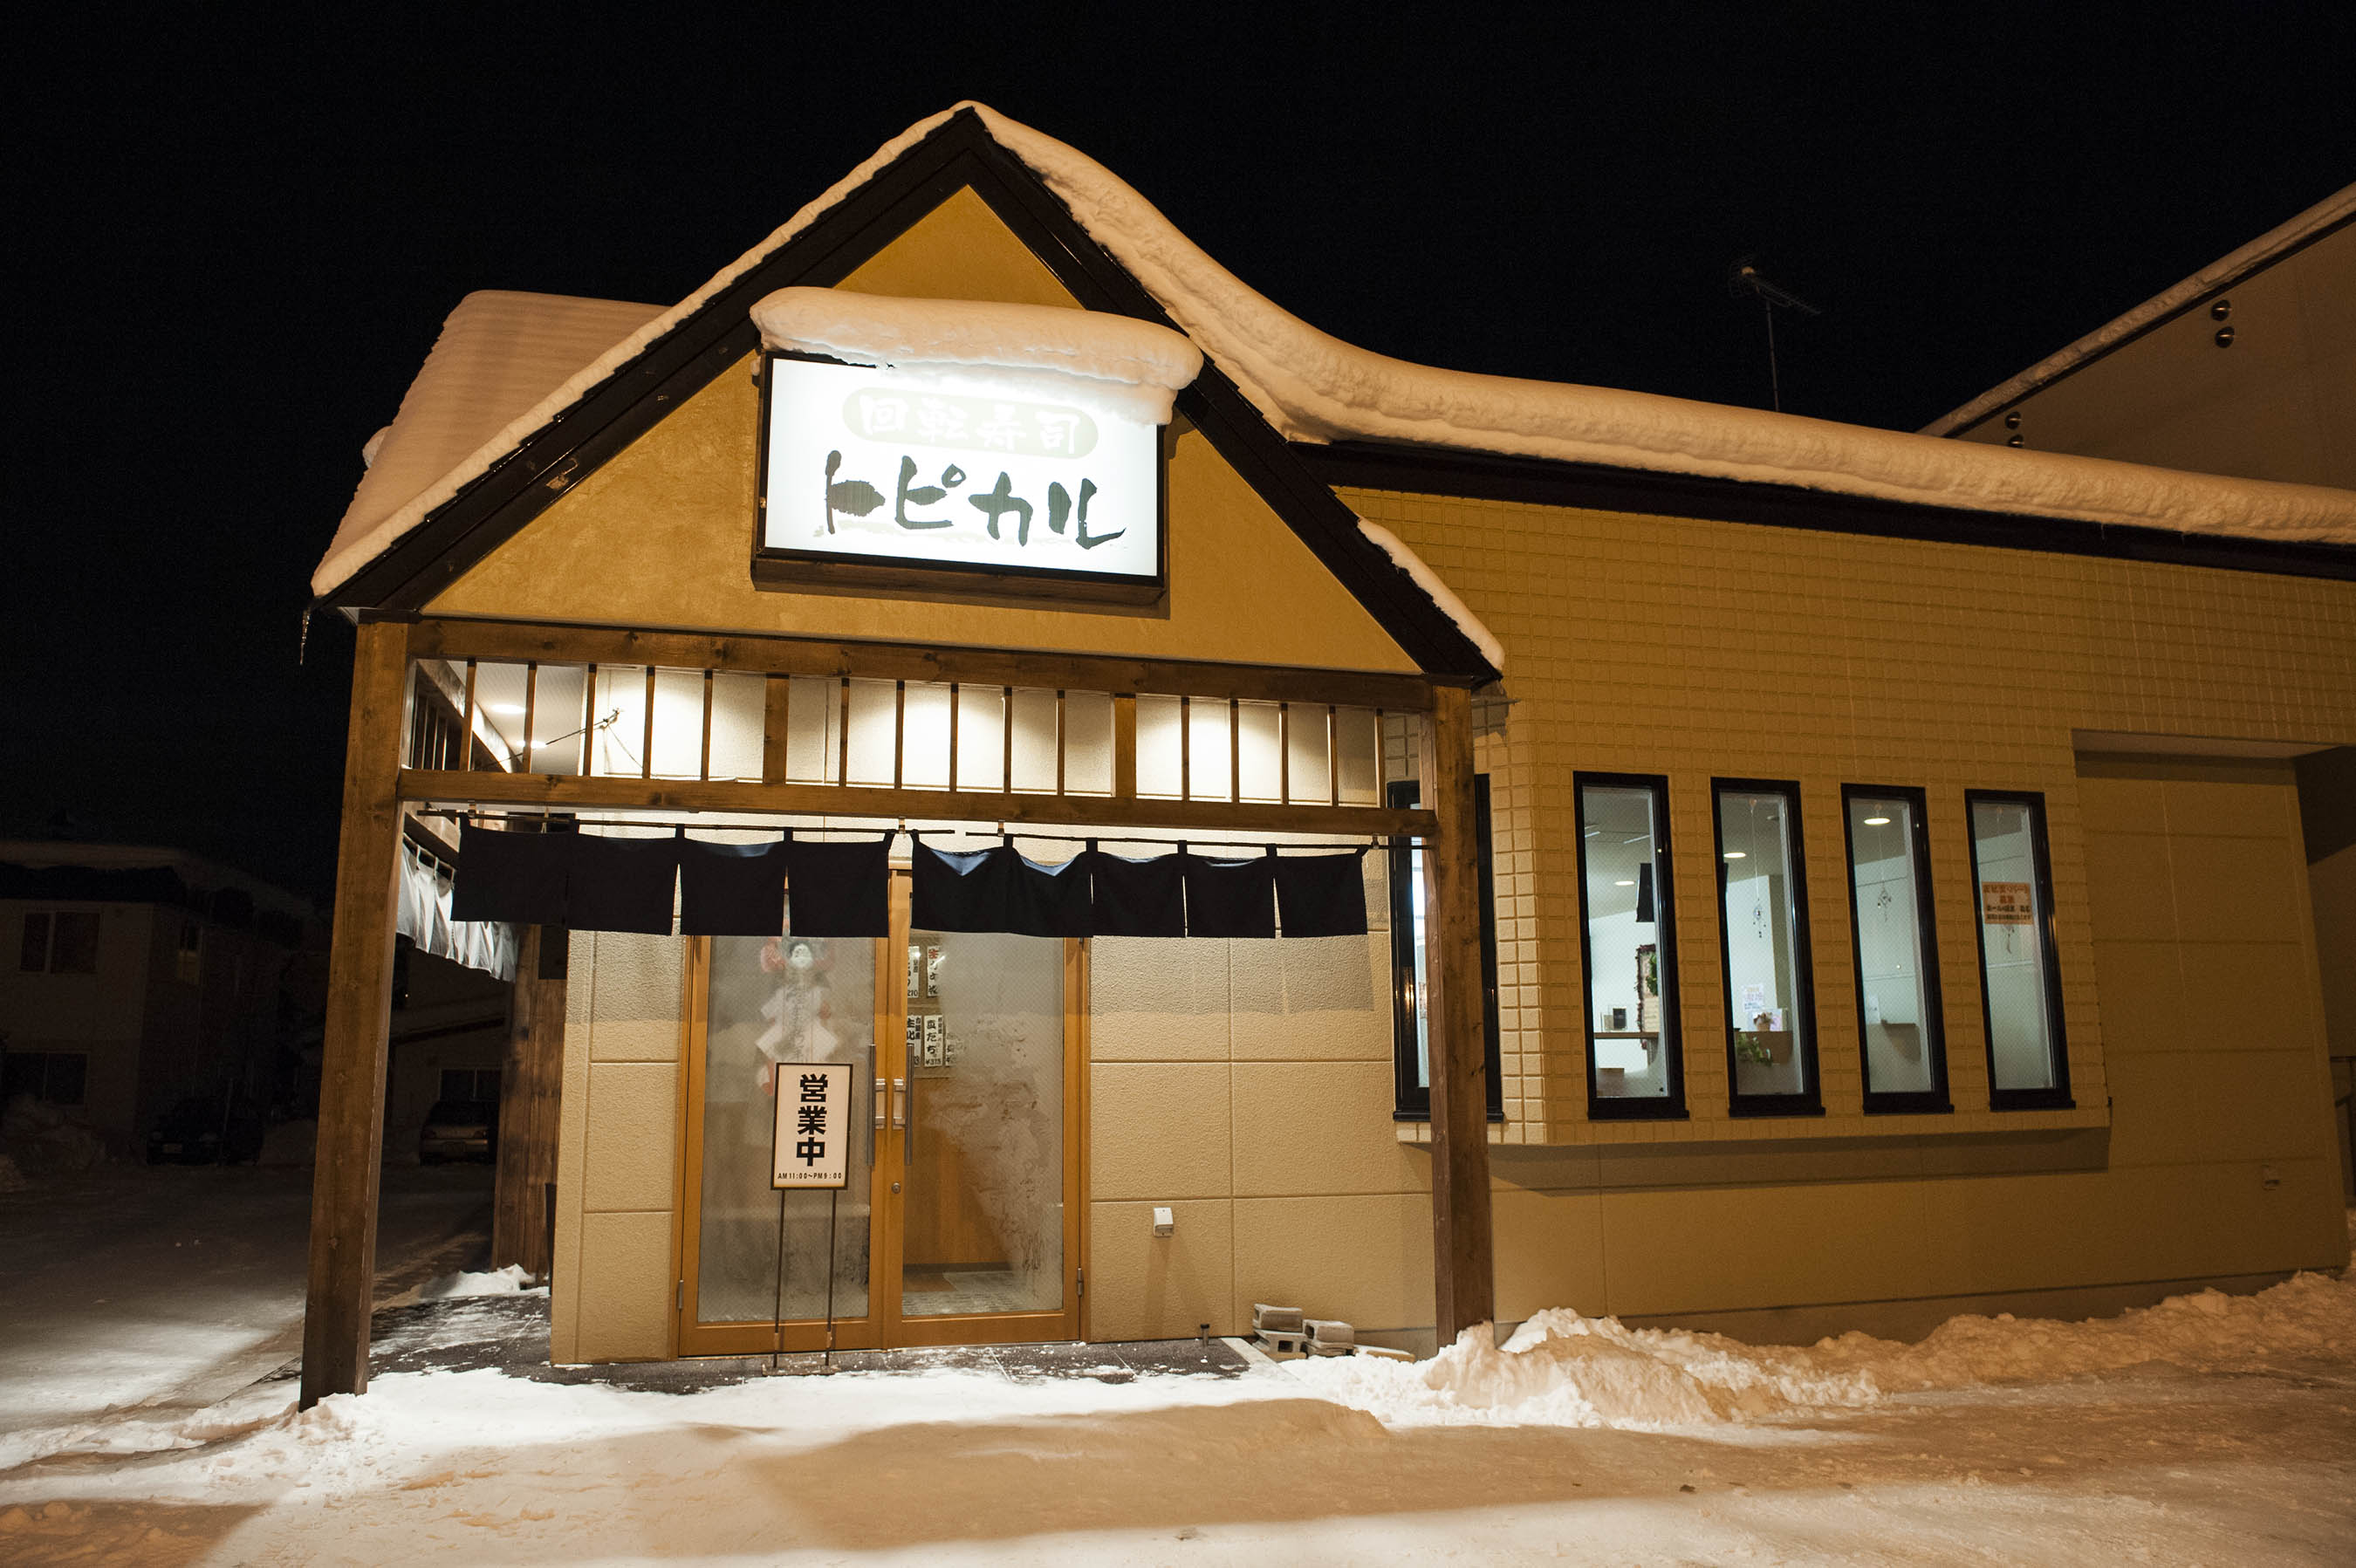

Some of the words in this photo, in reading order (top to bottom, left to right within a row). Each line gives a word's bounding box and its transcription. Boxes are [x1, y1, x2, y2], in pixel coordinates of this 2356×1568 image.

[859, 394, 1082, 455] 回転寿司
[825, 449, 1127, 551] トピカル
[796, 1072, 829, 1167] 営業中
